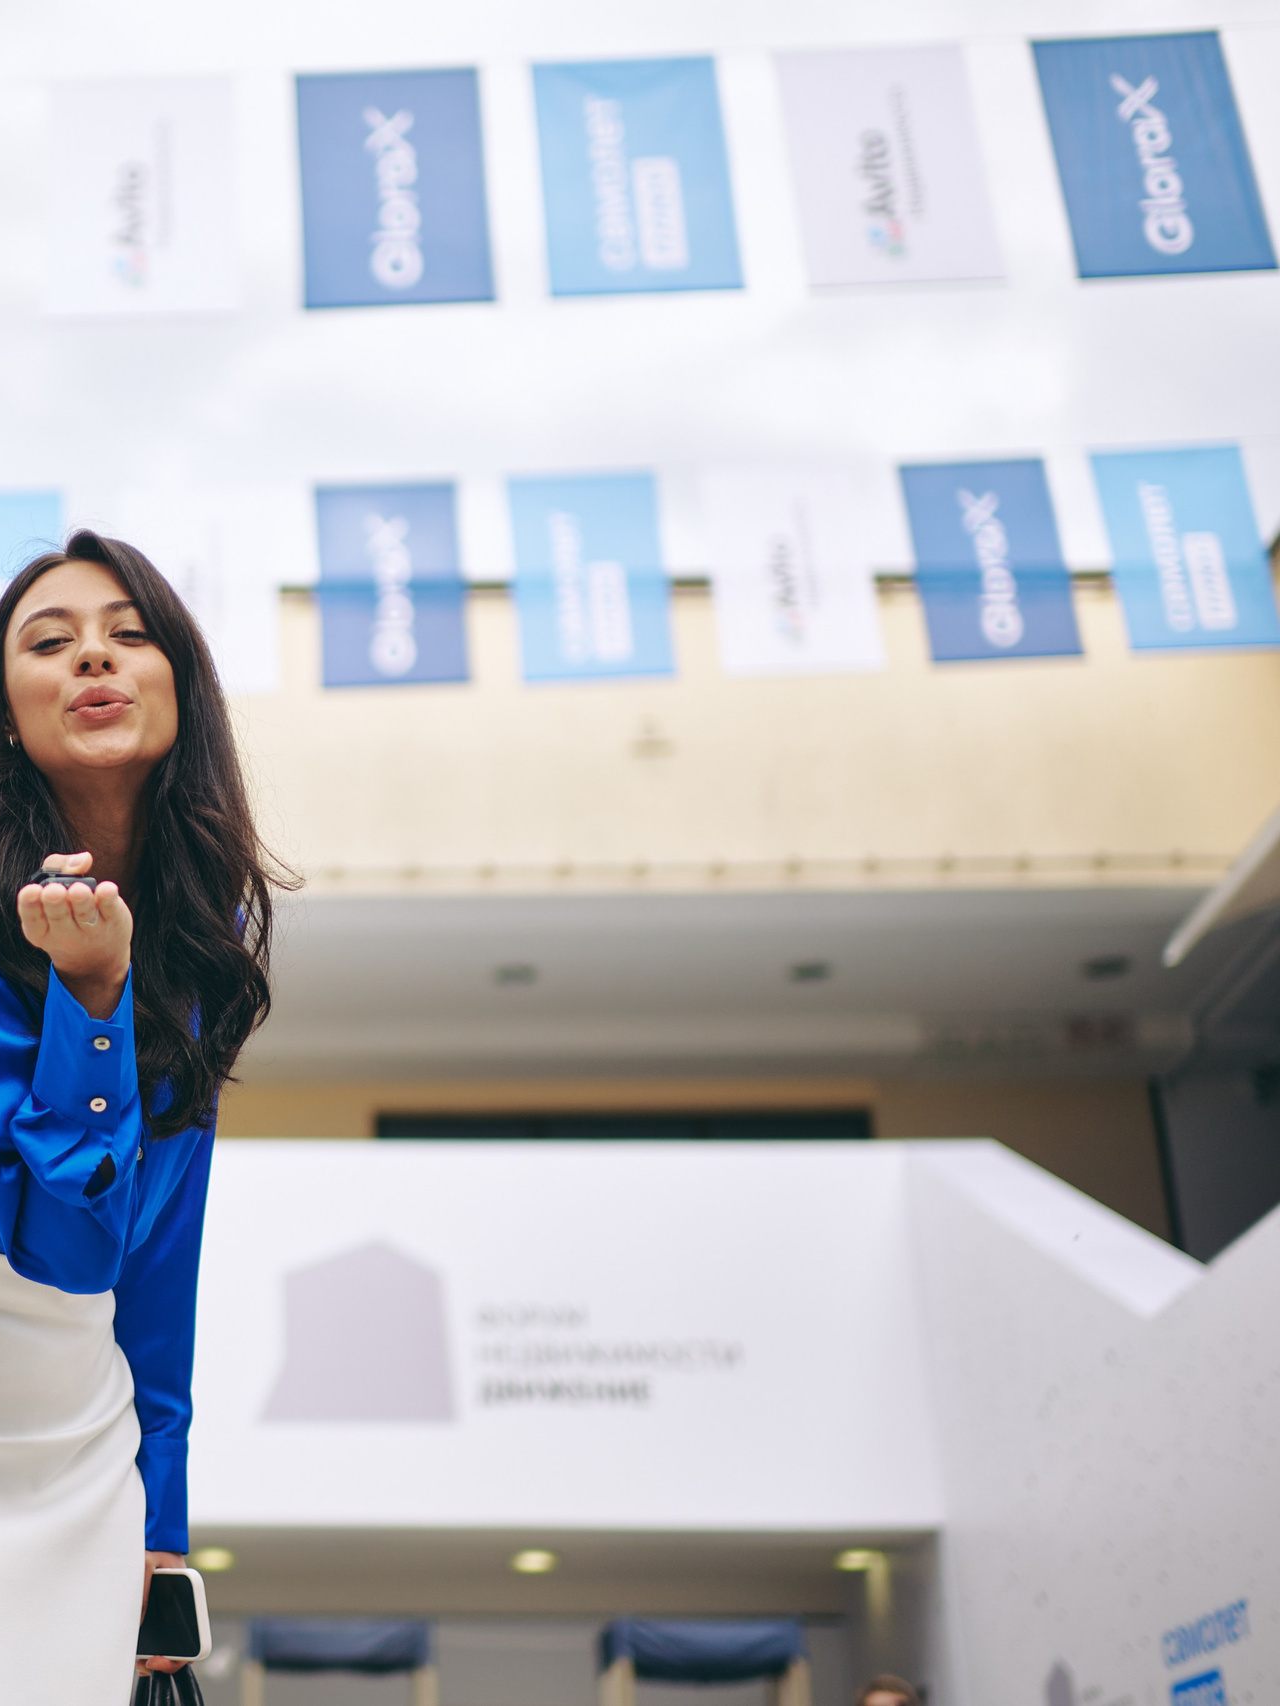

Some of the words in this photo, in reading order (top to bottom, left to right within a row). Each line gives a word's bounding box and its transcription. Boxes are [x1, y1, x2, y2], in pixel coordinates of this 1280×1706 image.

[362, 105, 424, 289] GloraX
[1111, 73, 1194, 255] GloraX
[958, 488, 1023, 648] GloraX
